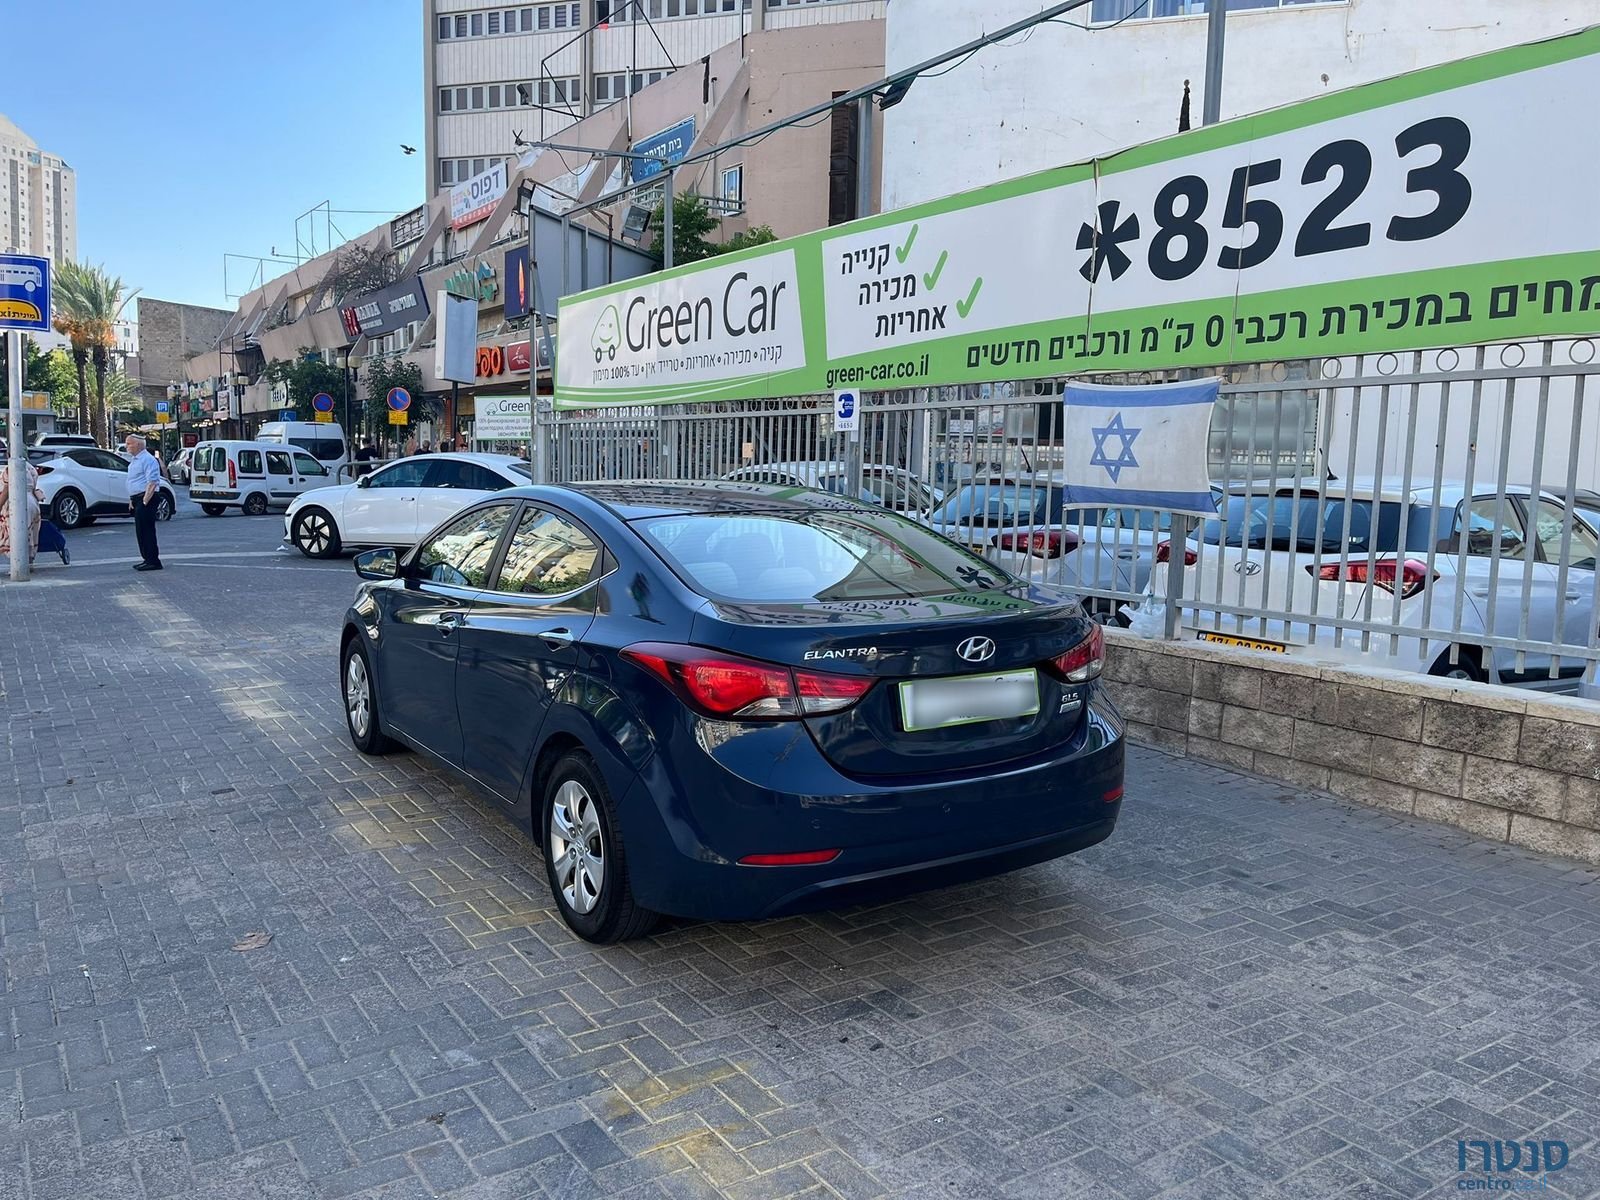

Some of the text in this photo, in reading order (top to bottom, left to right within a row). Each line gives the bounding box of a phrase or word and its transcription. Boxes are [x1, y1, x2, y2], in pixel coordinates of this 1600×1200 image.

[668, 138, 682, 153] בית
[471, 170, 500, 200] דפוס
[842, 243, 890, 275] קנייה
[859, 273, 917, 306] מכירה
[626, 272, 786, 352] Green Car
[875, 305, 948, 338] אחריות
[1318, 291, 1473, 337] במכירת
[1205, 314, 1224, 347] 0
[1235, 310, 1307, 344] רכבי
[723, 349, 752, 366] מכירה
[760, 345, 782, 364] קניה
[967, 339, 1041, 368] חדשים
[1049, 329, 1131, 361] ורכבים
[611, 365, 630, 379] 100%
[630, 364, 640, 377] עד
[658, 358, 679, 373] טרייד
[686, 353, 716, 370] אחריות
[826, 353, 929, 389] green-car.co.il
[499, 400, 531, 412] Green
[804, 647, 878, 660] ELANTRA
